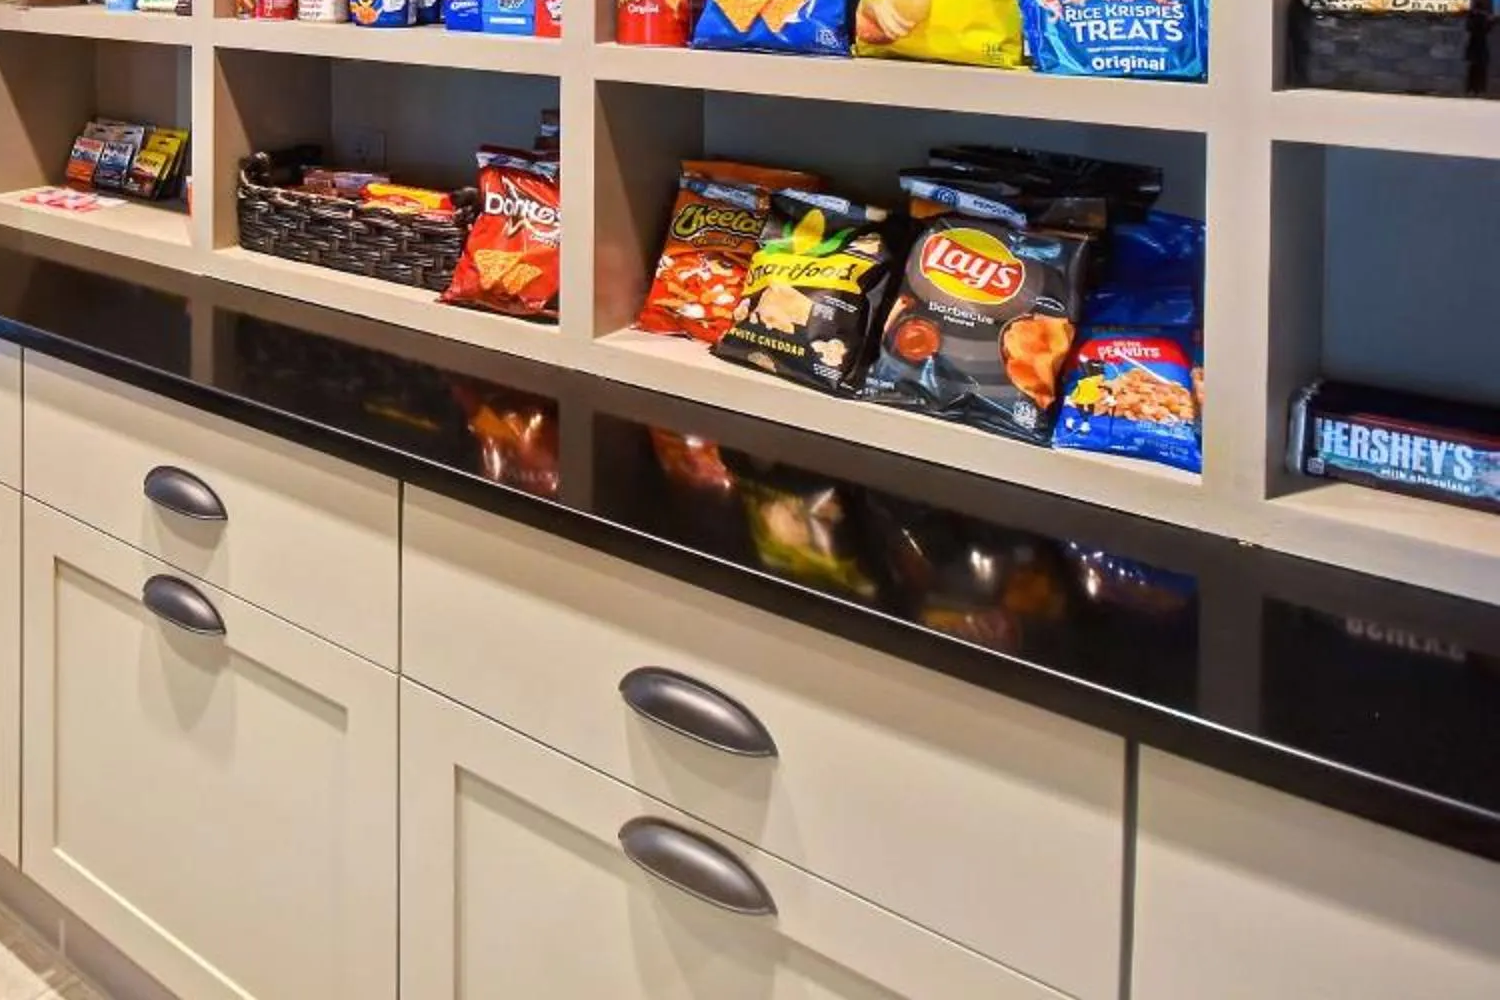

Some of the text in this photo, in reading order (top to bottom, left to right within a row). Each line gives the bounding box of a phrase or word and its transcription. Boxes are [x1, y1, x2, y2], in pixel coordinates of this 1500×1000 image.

[1065, 3, 1185, 22] RICE KRISPIES
[1070, 19, 1184, 42] TREATS
[926, 239, 1020, 290] Lay's
[1097, 344, 1160, 359] PEANUTS
[1315, 417, 1474, 481] HERSHEY'S
